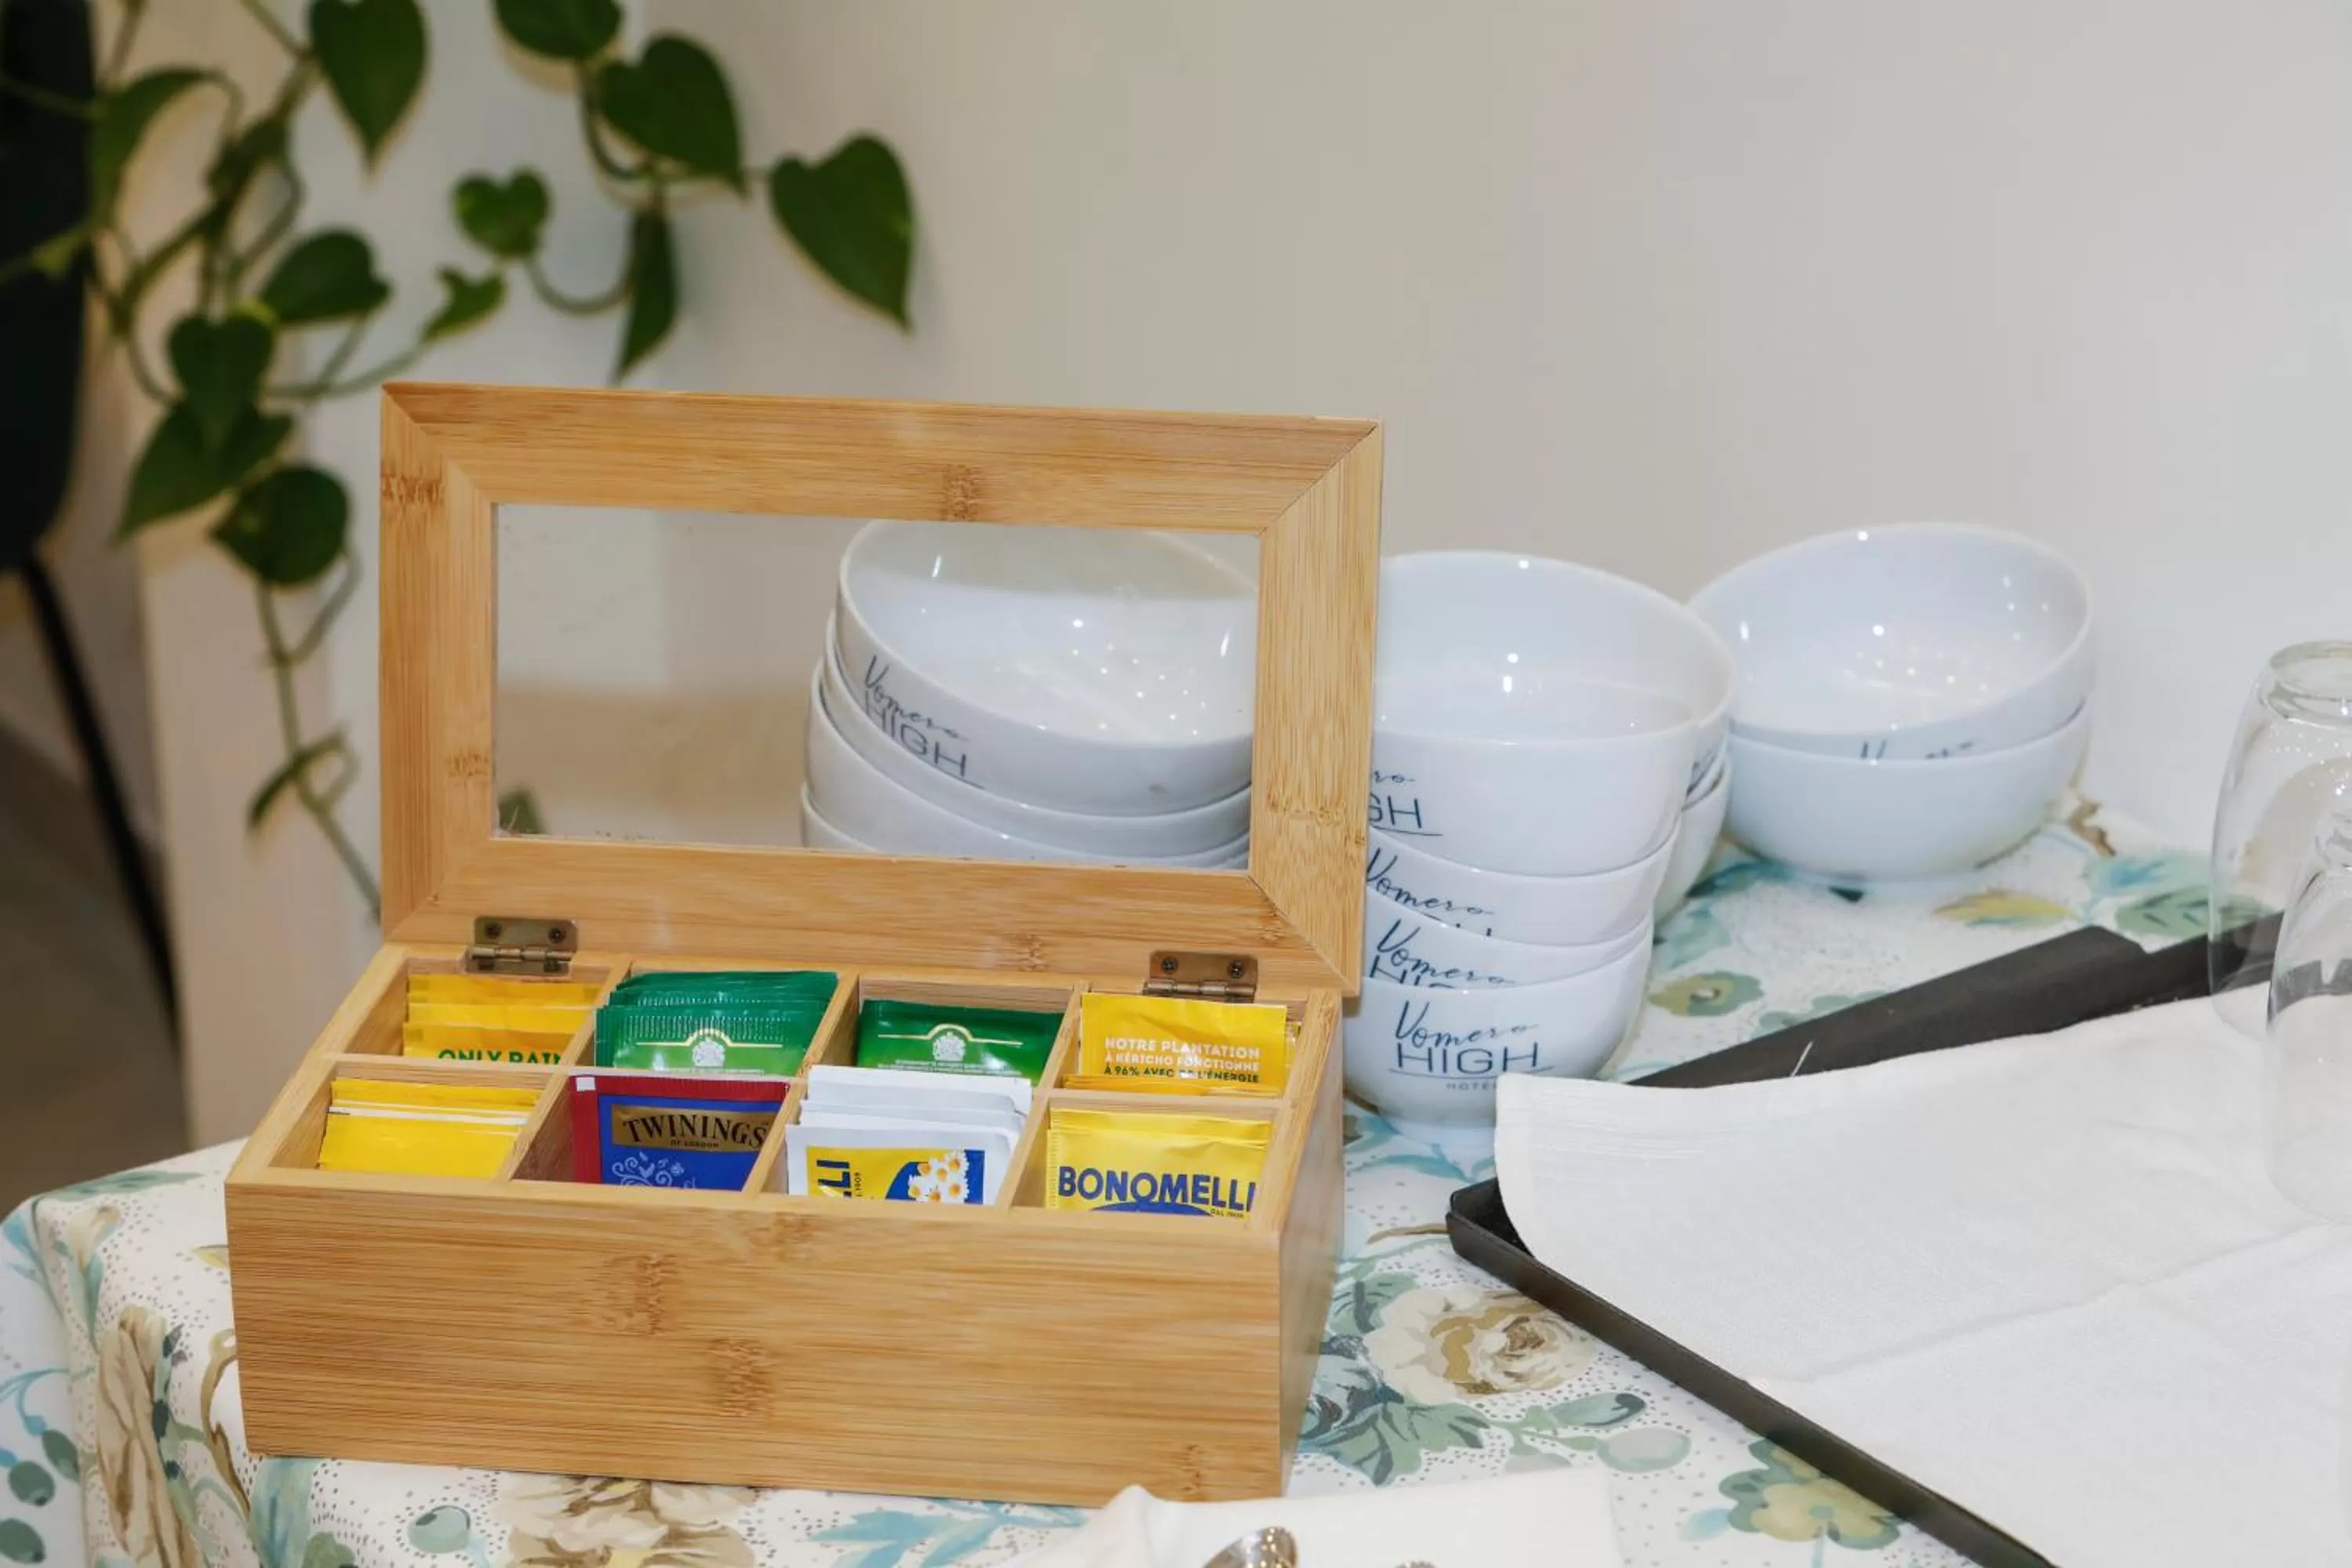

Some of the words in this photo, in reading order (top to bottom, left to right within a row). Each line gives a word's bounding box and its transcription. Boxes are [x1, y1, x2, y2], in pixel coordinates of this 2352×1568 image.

[865, 655, 971, 743] Vomero
[865, 689, 966, 777] HIGH
[1367, 848, 1494, 914] Vomero
[1376, 919, 1516, 982] Vomero
[1105, 1036, 1156, 1052] NOTRE
[1161, 1040, 1261, 1058] PLANTATION
[1396, 1000, 1541, 1049] Vomero
[1144, 1066, 1175, 1078] AVEC
[1396, 1040, 1542, 1075] HIGH
[622, 1113, 767, 1150] TWININGS
[1058, 1166, 1257, 1212] BONOMELLI
